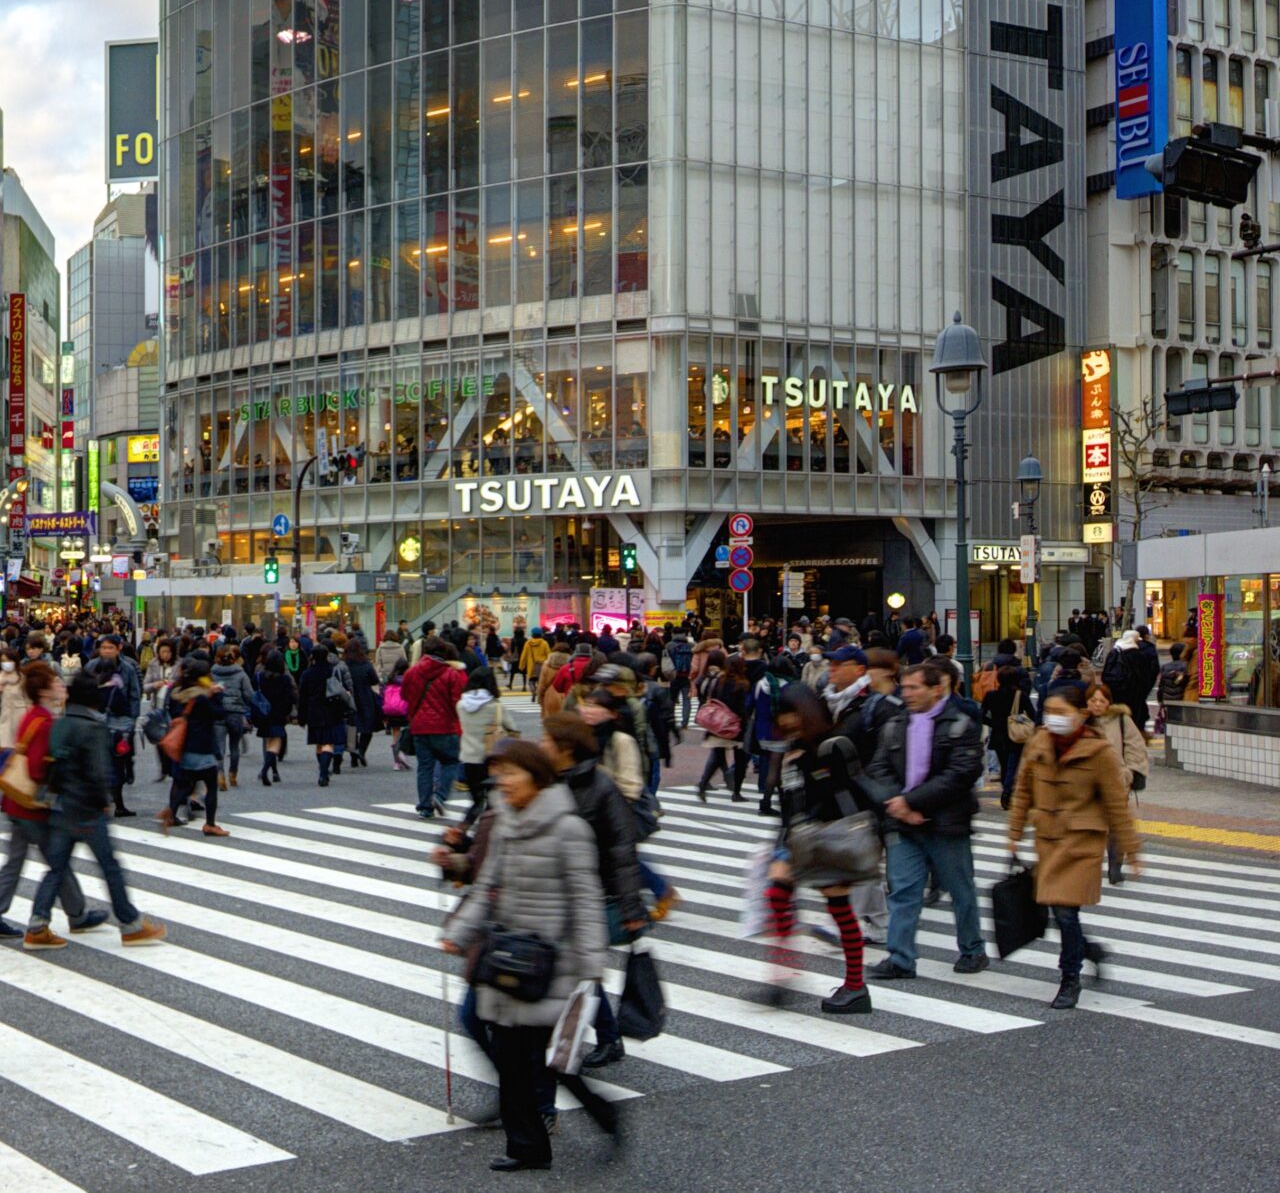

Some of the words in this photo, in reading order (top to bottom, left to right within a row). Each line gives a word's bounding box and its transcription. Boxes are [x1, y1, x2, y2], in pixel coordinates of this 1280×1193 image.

[1117, 41, 1151, 173] SEIBU
[11, 297, 24, 387] クスリのことなら
[240, 387, 376, 422] STARBUCKS
[761, 375, 918, 414] TSUTAYA
[10, 392, 24, 449] 三千里
[1087, 445, 1107, 467] 本
[455, 475, 640, 512] TSUTAYA
[842, 558, 879, 566] COFFEE
